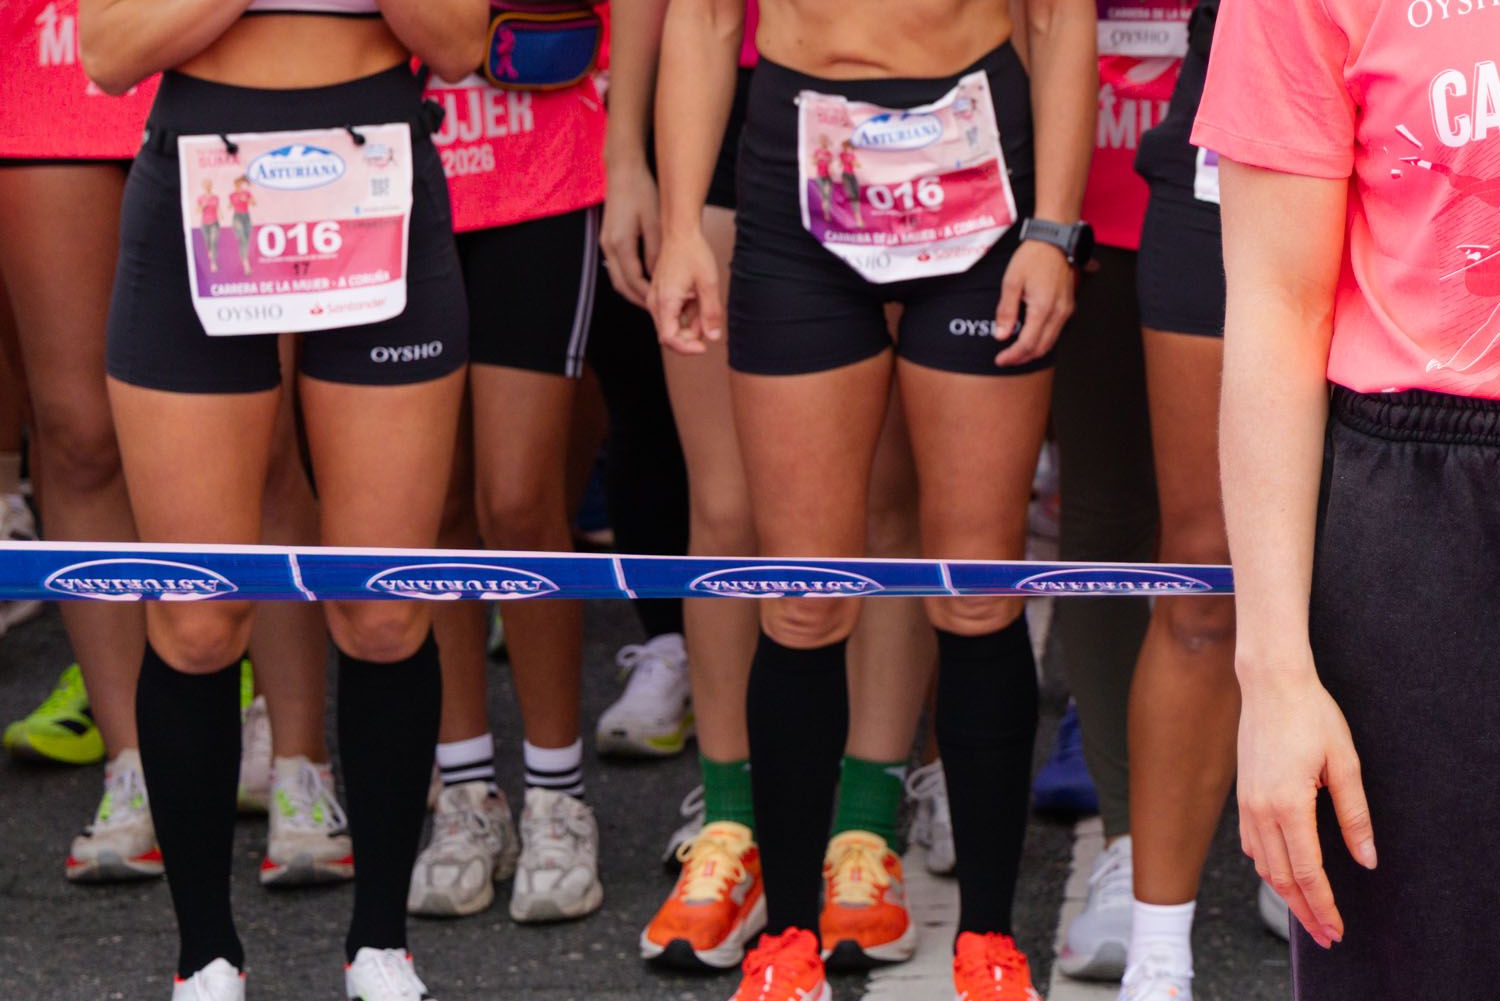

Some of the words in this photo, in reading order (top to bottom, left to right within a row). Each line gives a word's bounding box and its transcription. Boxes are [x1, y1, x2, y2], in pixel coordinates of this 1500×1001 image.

[1111, 29, 1169, 45] OYSHO
[428, 88, 534, 146] UJER
[859, 122, 939, 146] ASTURIANA
[258, 164, 338, 180] ASTURIANA
[866, 176, 944, 211] 016
[257, 221, 342, 257] 016
[293, 262, 310, 276] 17
[210, 282, 258, 296] CARRERA
[260, 281, 273, 293] DE
[276, 280, 290, 292] LA
[292, 277, 330, 290] MUJER
[338, 276, 346, 287] A
[217, 305, 283, 322] OYSHO
[370, 341, 443, 362] OYSHO
